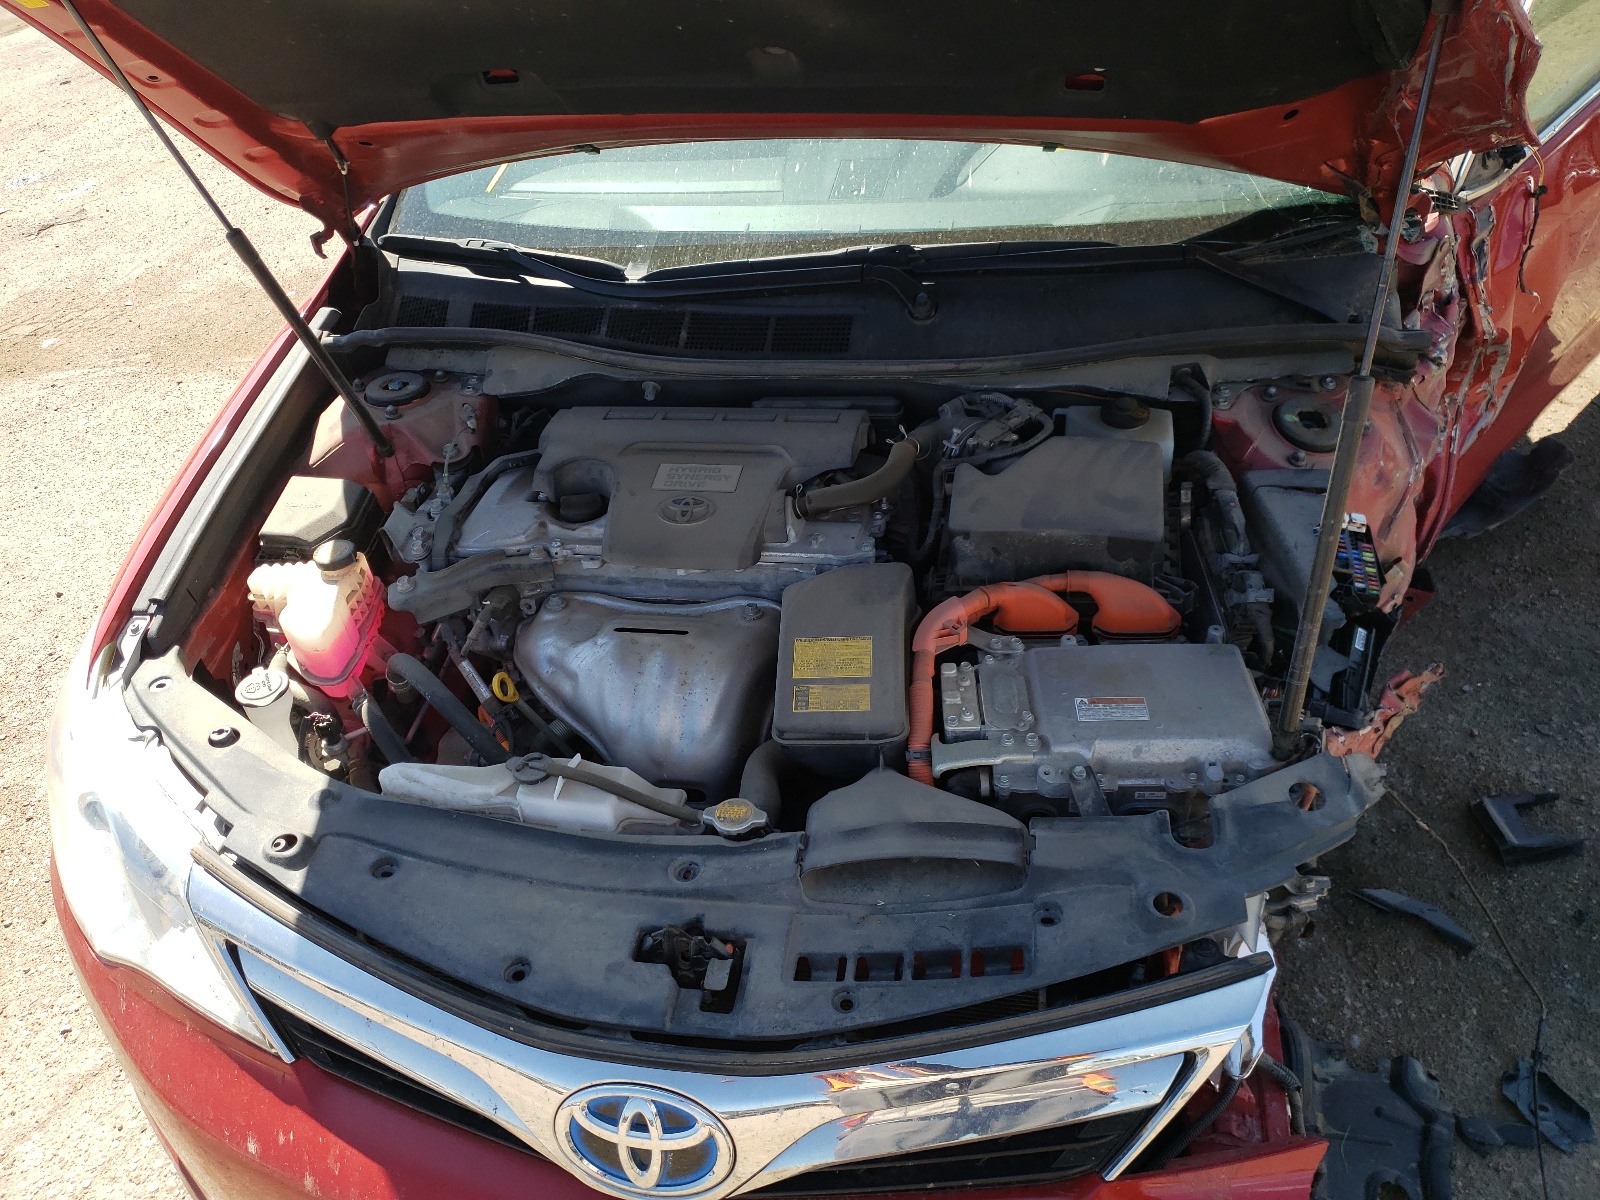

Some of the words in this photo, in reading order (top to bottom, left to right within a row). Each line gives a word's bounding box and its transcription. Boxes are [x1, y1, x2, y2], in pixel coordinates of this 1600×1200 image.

[669, 466, 721, 474] HYBRID
[666, 473, 732, 481] SYNERGY
[664, 480, 707, 488] DRIVE
